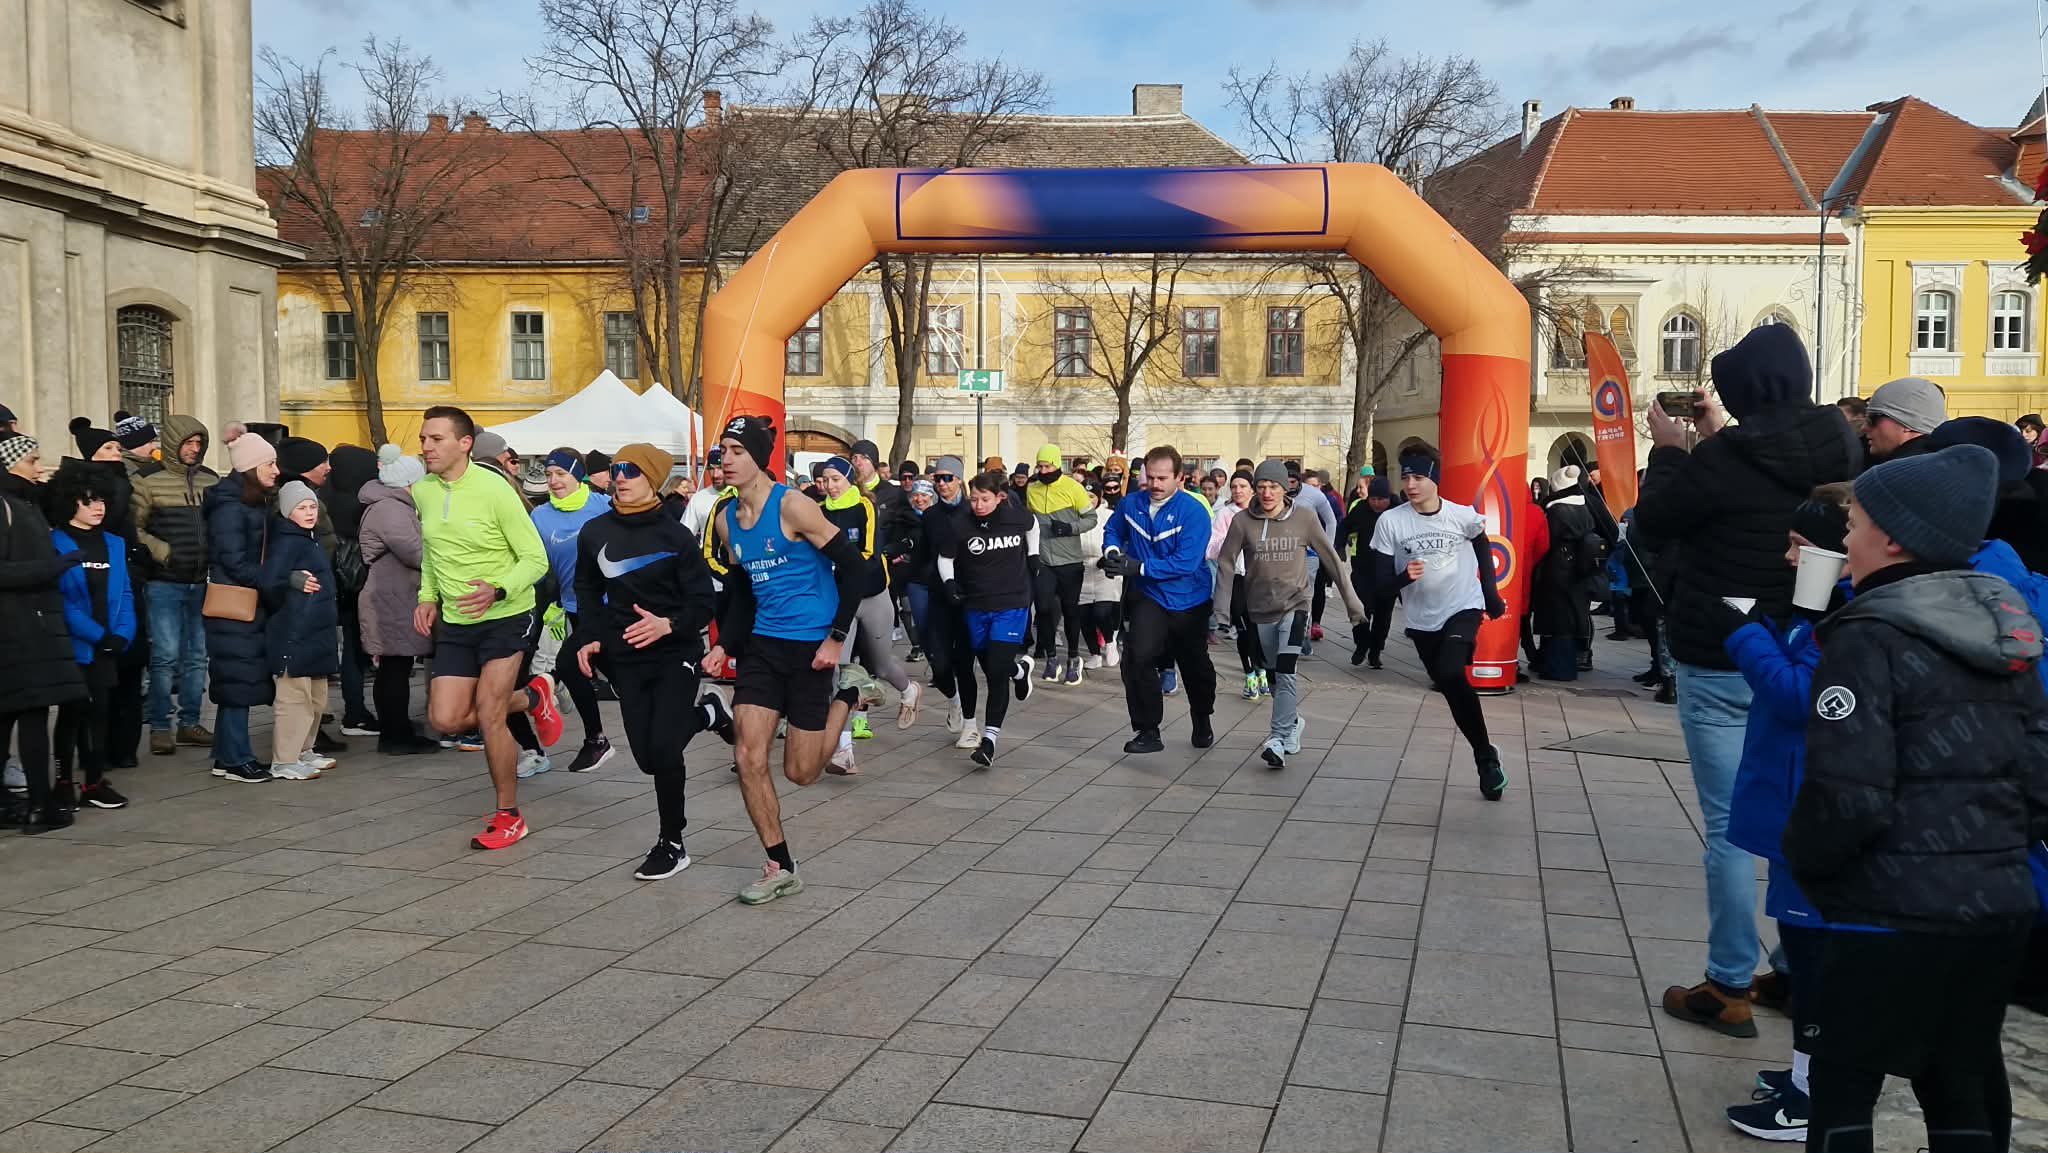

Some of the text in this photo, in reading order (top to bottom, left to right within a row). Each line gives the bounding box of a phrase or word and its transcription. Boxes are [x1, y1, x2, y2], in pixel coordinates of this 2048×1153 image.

[987, 535, 1021, 550] JAKO
[1255, 536, 1300, 552] ETROIT
[1254, 551, 1296, 562] PRO EDGE
[751, 571, 770, 583] CLUB
